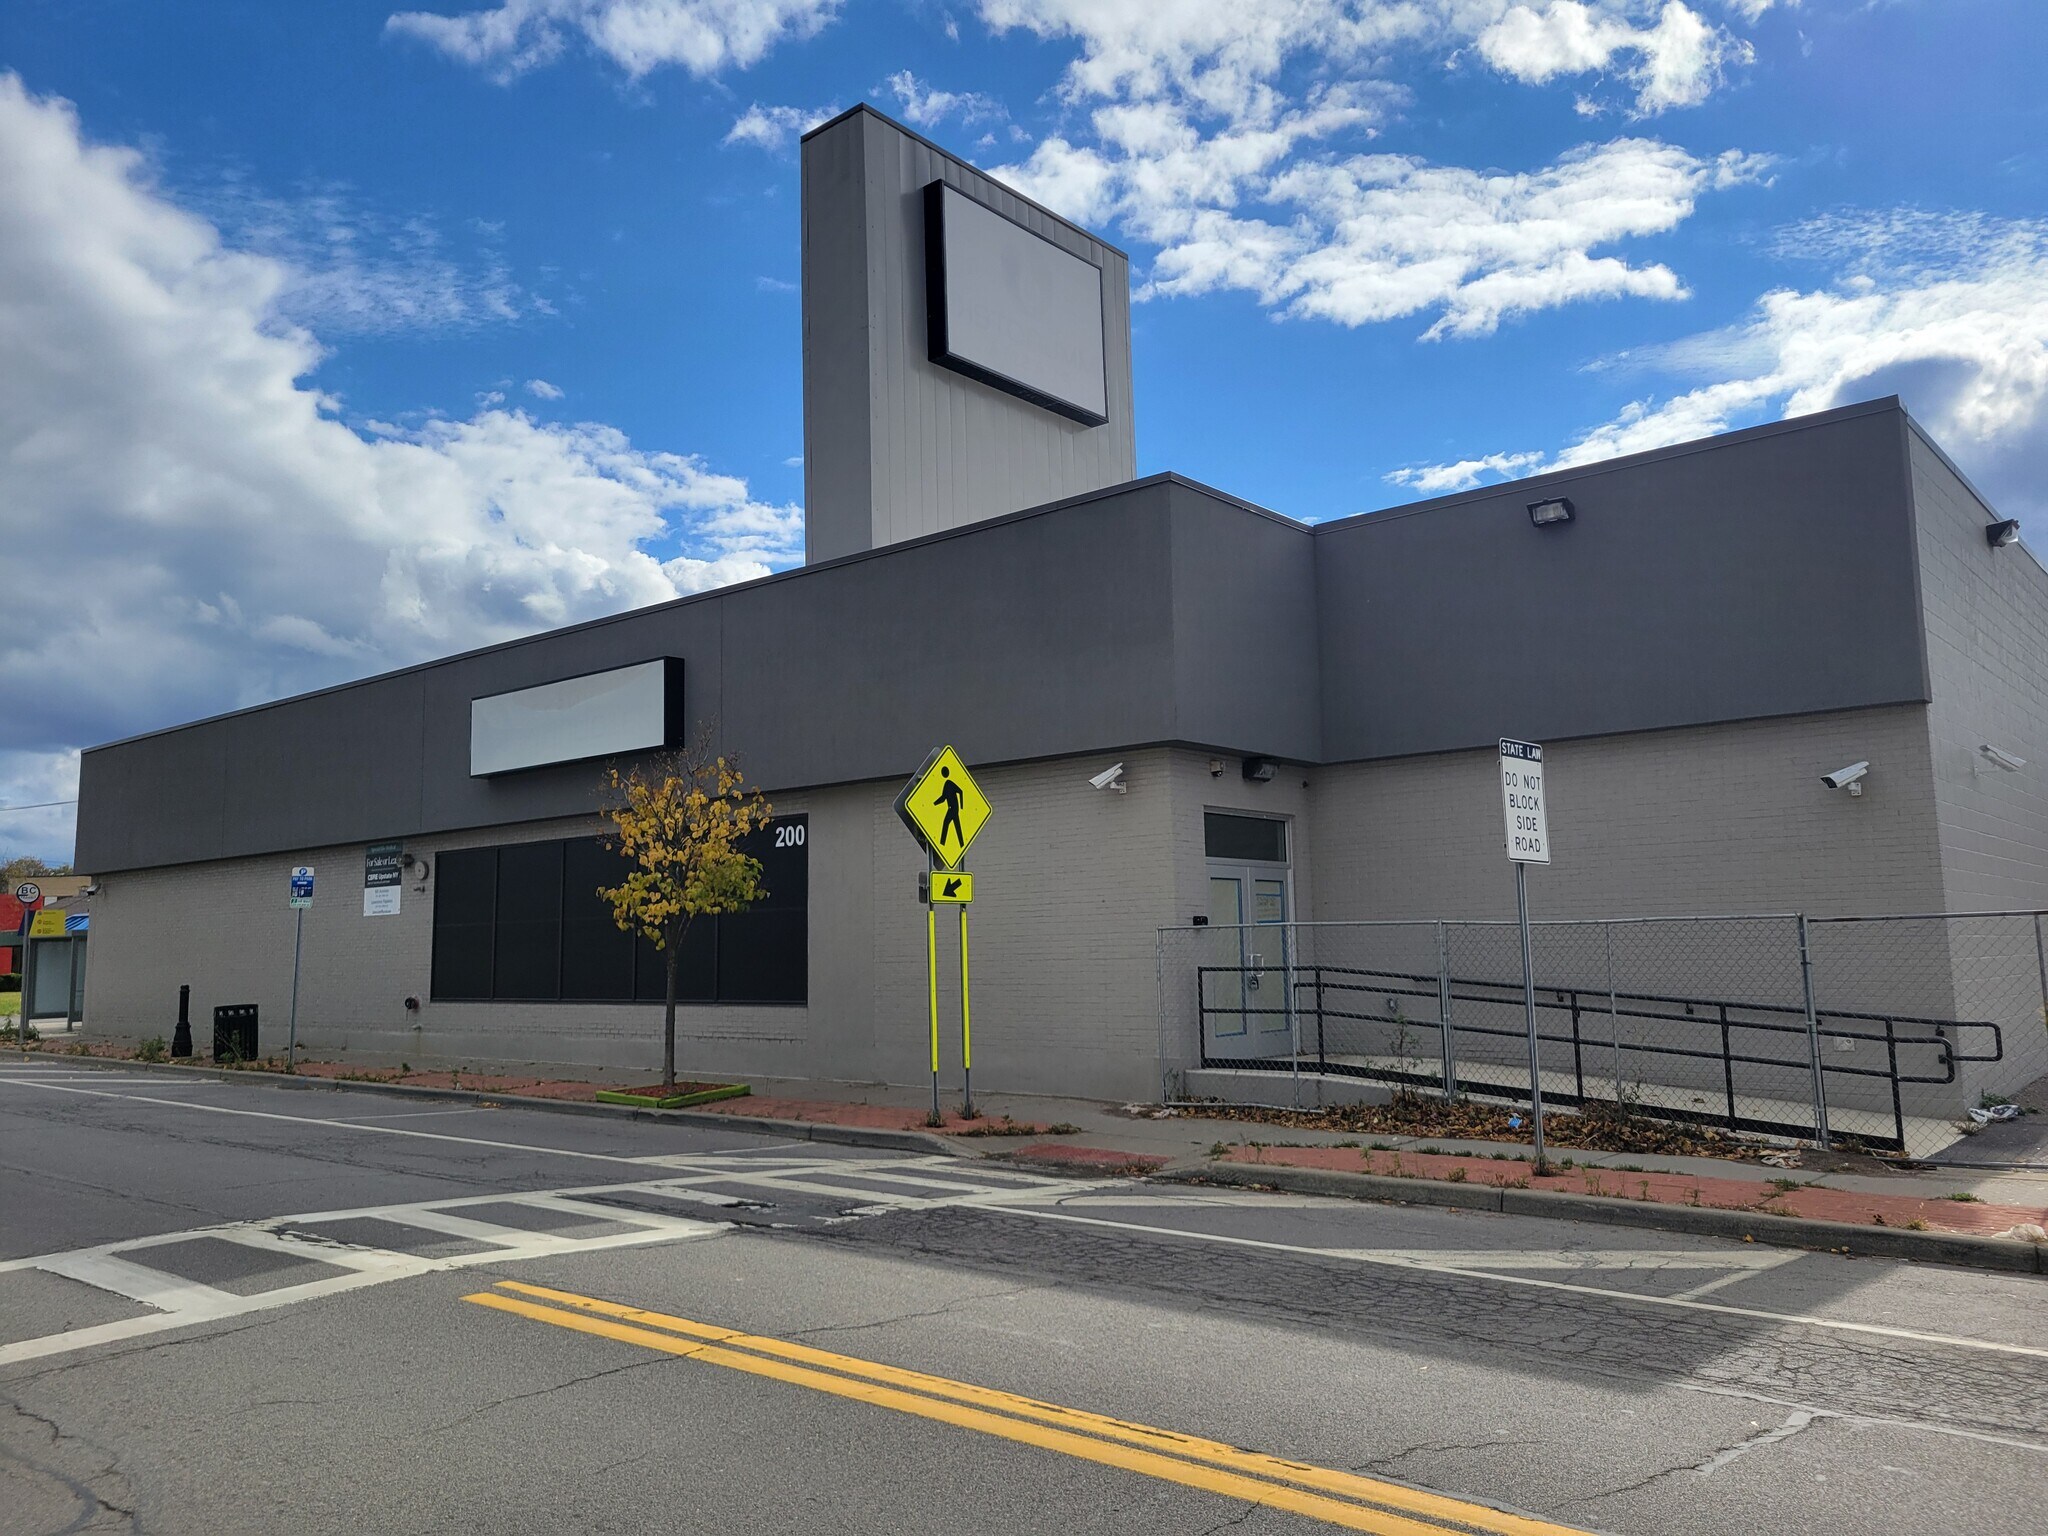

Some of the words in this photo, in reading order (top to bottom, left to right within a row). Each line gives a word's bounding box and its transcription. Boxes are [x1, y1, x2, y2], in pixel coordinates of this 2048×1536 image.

[1502, 742, 1524, 757] STATE
[1527, 747, 1541, 760] LAW
[1505, 771, 1518, 787] DO
[1523, 774, 1541, 791] NOT
[1509, 793, 1540, 811] BLOCK
[1516, 815, 1538, 832] SIDE
[775, 824, 805, 848] 200
[1515, 836, 1541, 853] ROAD
[373, 857, 383, 867] Sale
[392, 871, 399, 879] NY
[21, 886, 37, 894] BC
